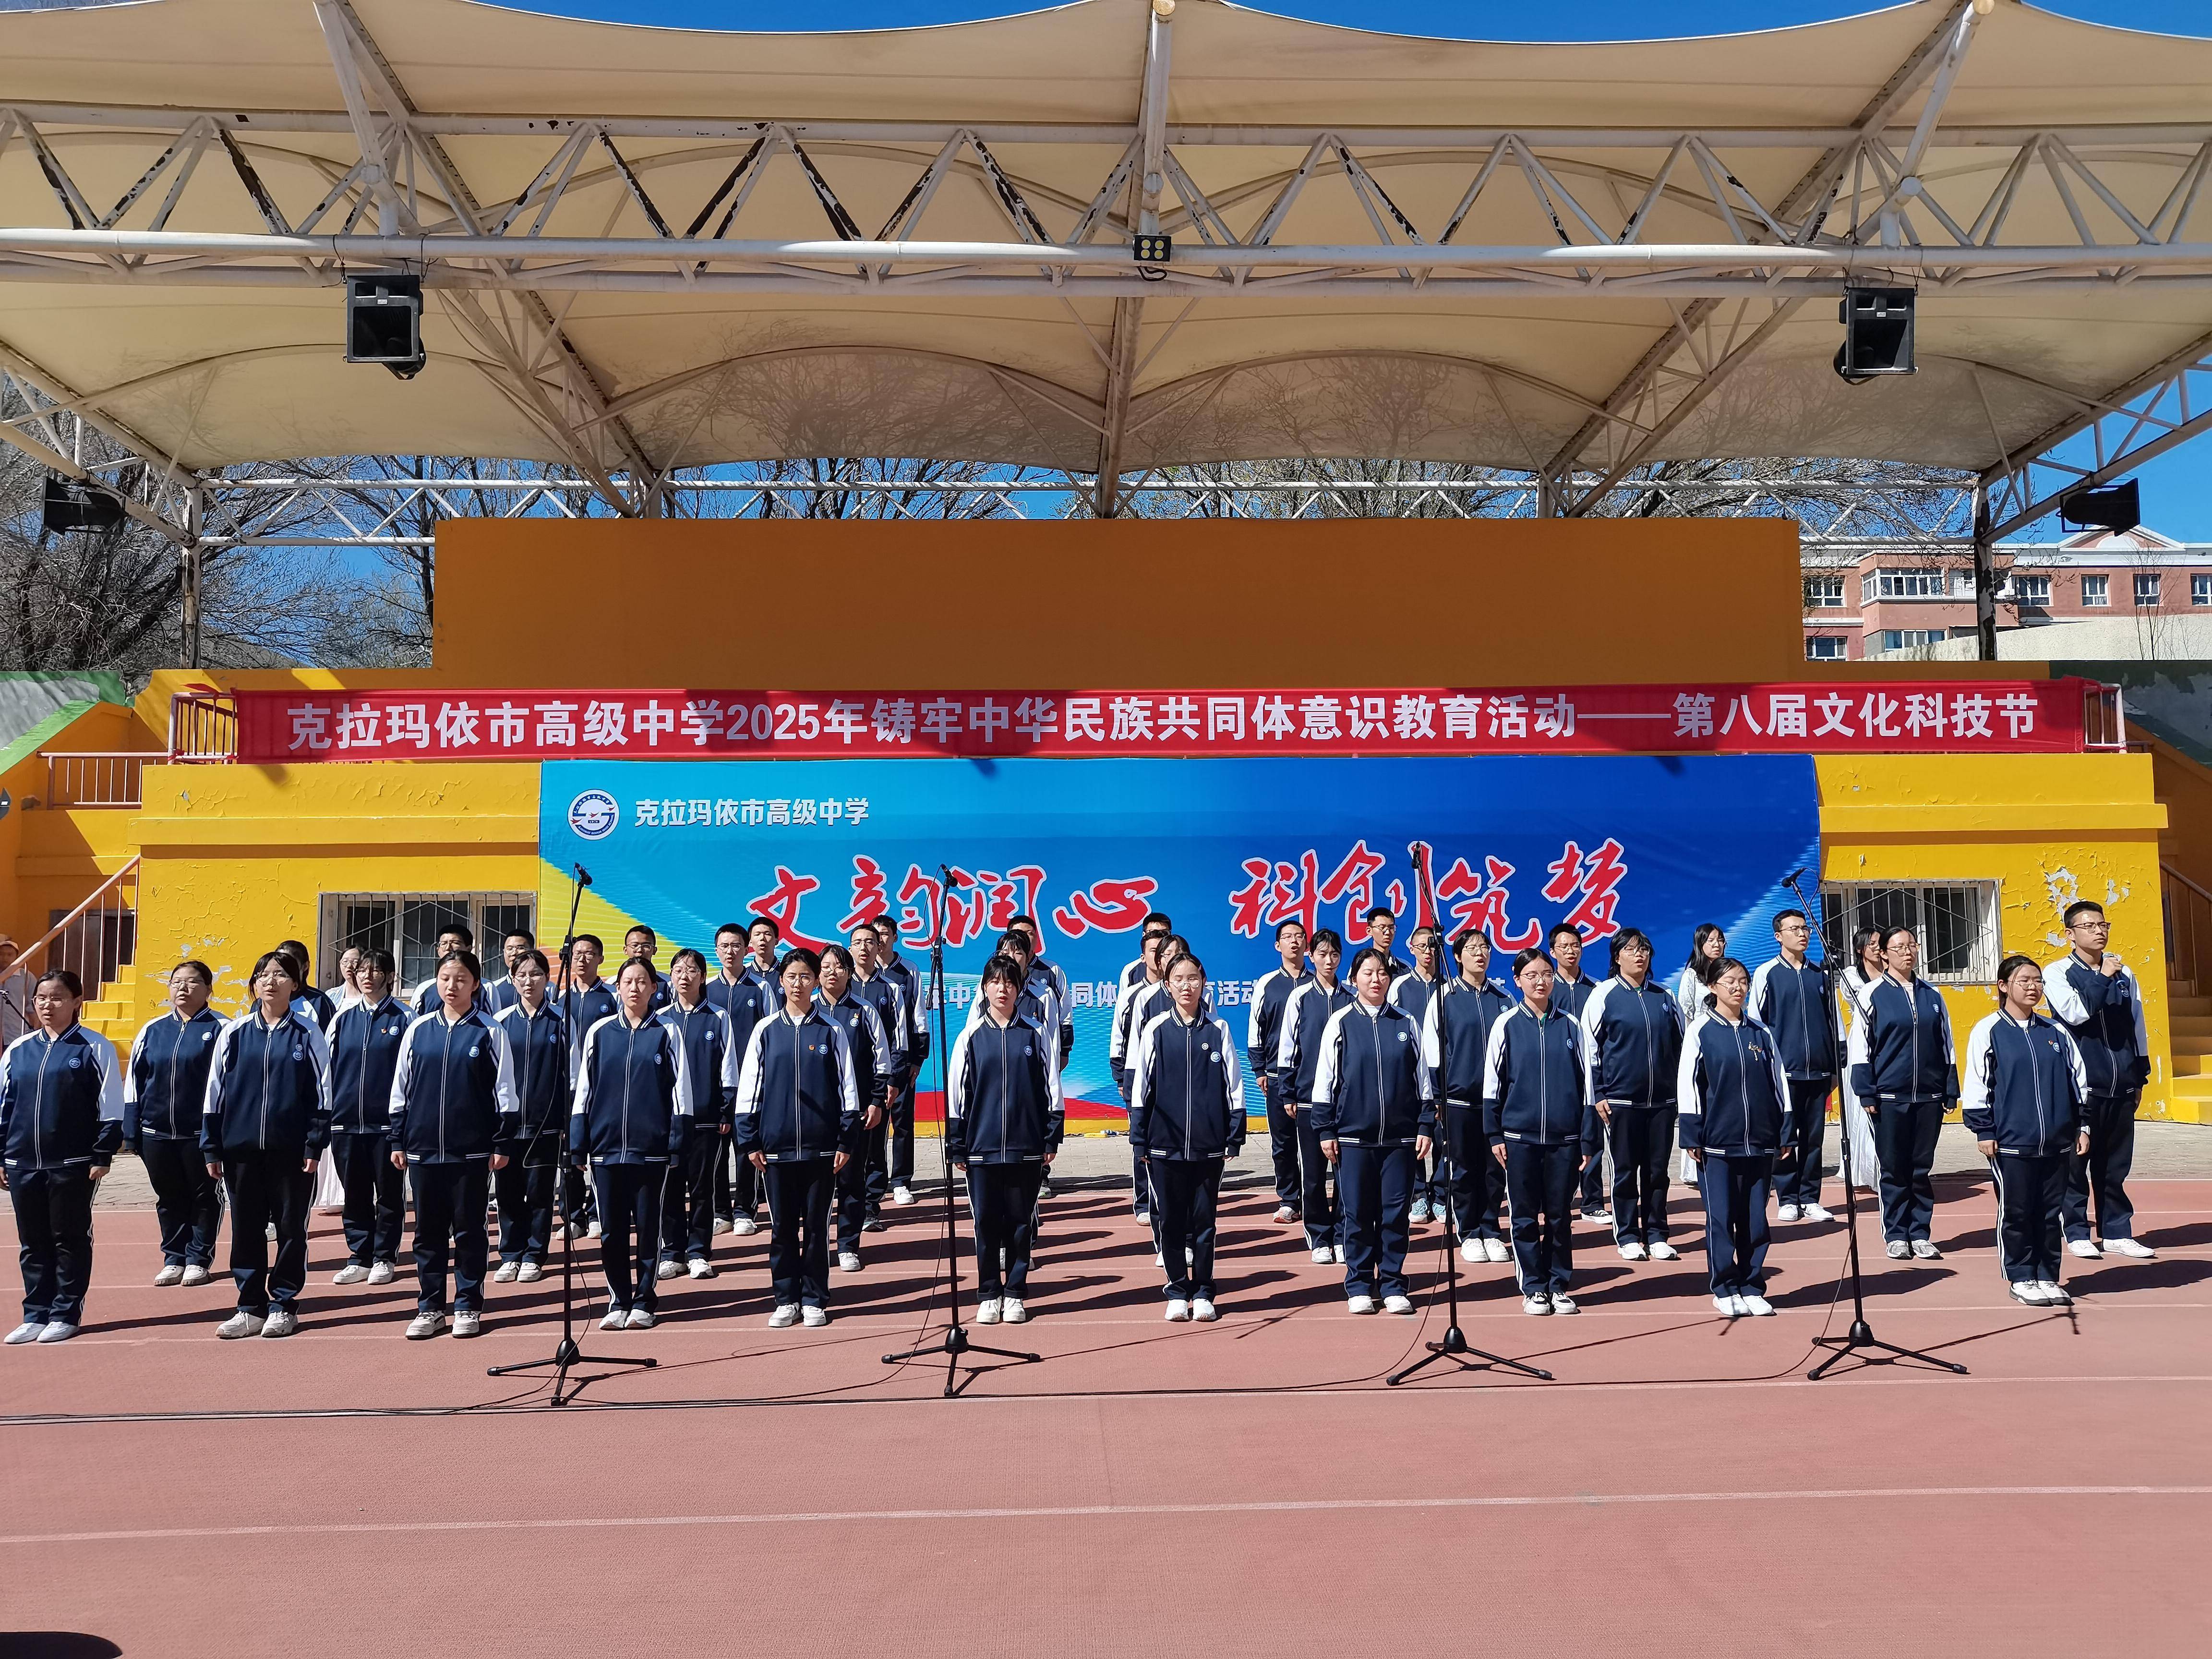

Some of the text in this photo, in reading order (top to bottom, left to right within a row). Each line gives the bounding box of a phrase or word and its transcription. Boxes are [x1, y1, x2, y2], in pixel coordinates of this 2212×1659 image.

[287, 692, 2038, 750] 克拉玛依市高级中学2025年铸牢中华民族共同体意识教育活动——第八届文化科技节
[635, 797, 869, 827] 克拉玛依市高级中学
[747, 854, 1158, 956] 文韵润心
[1229, 838, 1628, 954] 科创筑梦
